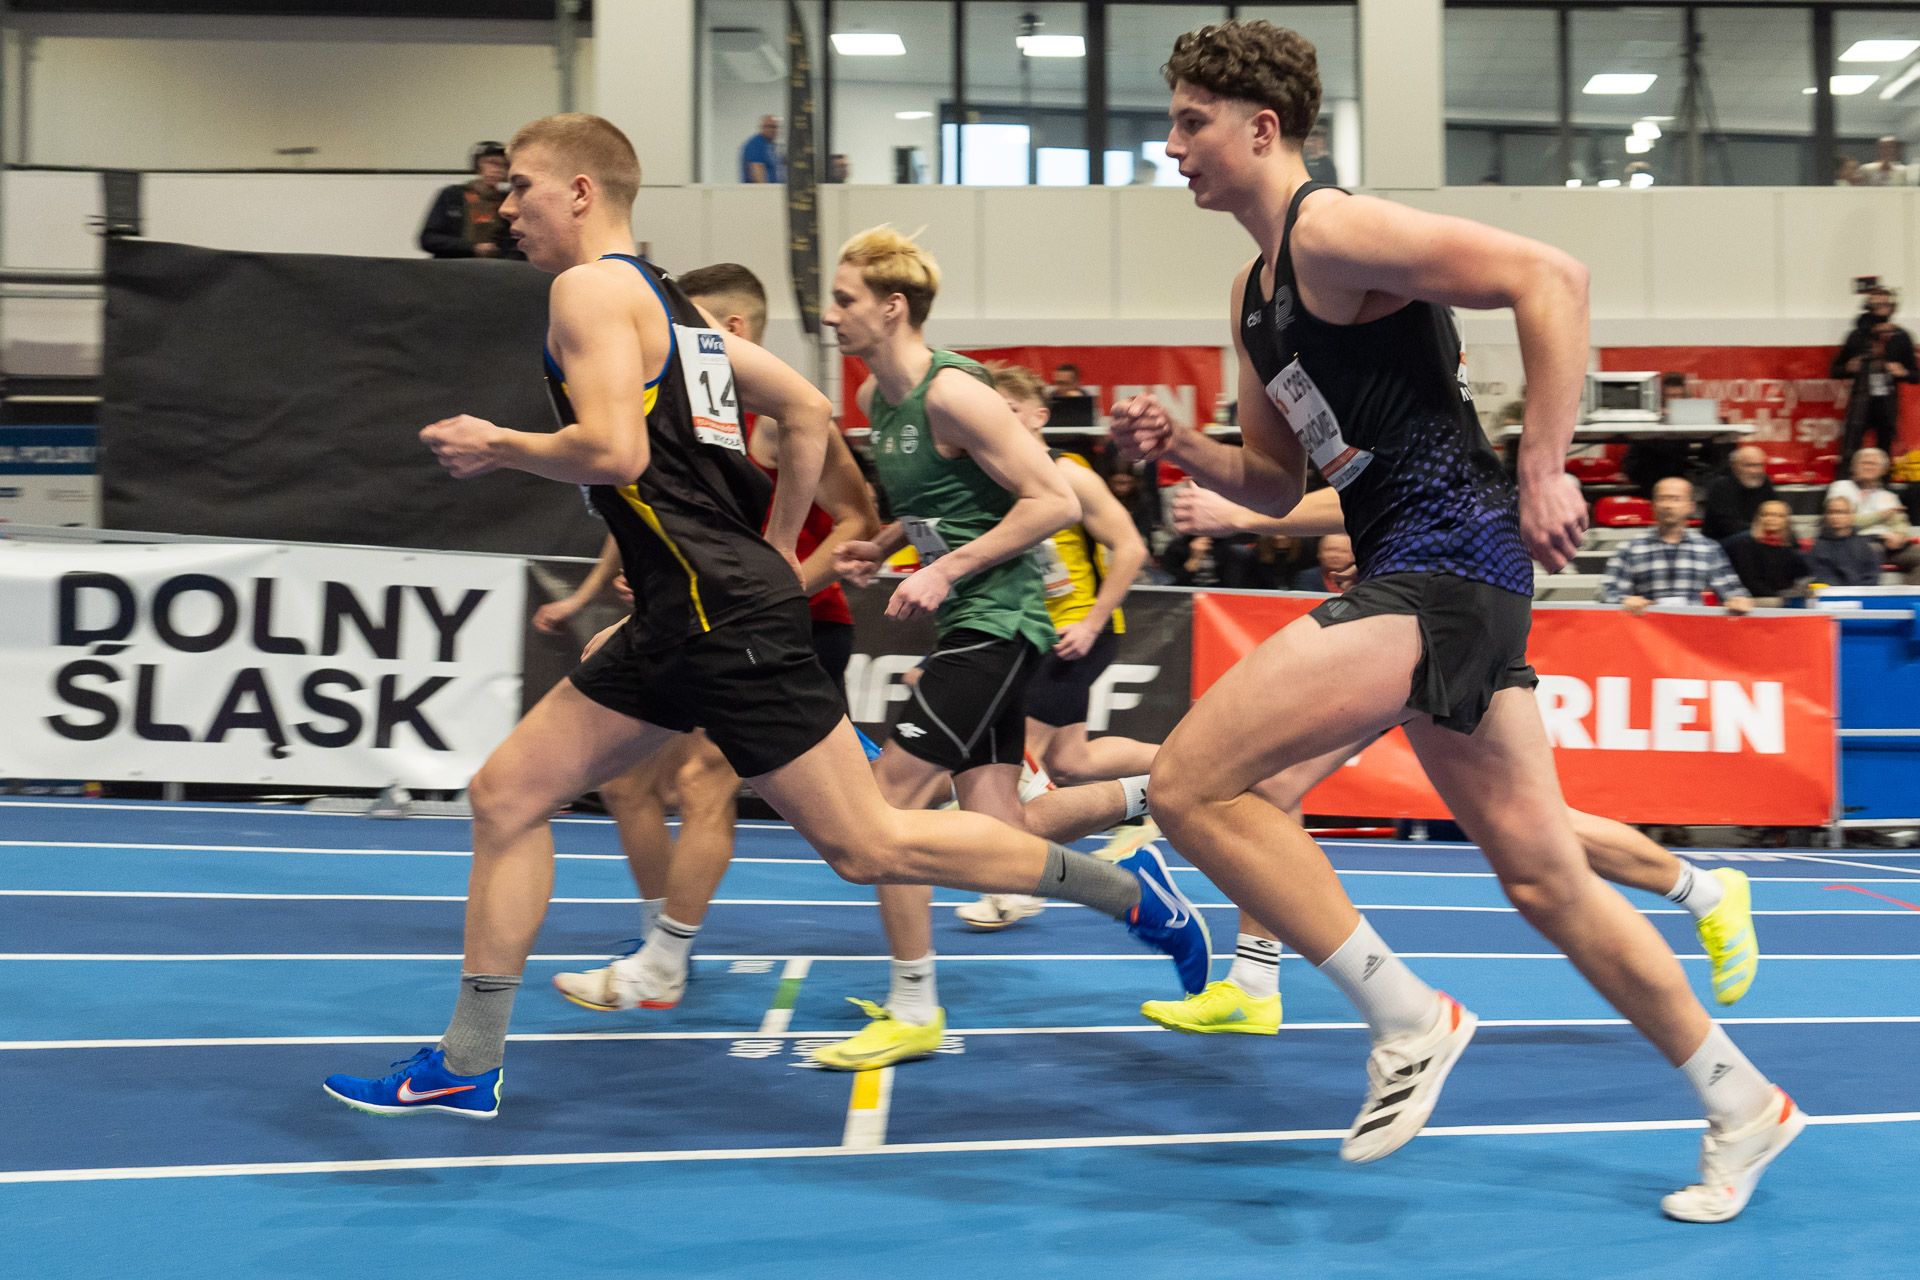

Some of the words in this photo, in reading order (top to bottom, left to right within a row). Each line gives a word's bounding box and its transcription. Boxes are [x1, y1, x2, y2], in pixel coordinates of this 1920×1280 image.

[55, 571, 494, 662] DOLNY
[45, 644, 458, 759] ŚLĄSK
[1536, 674, 1786, 754] RLEN
